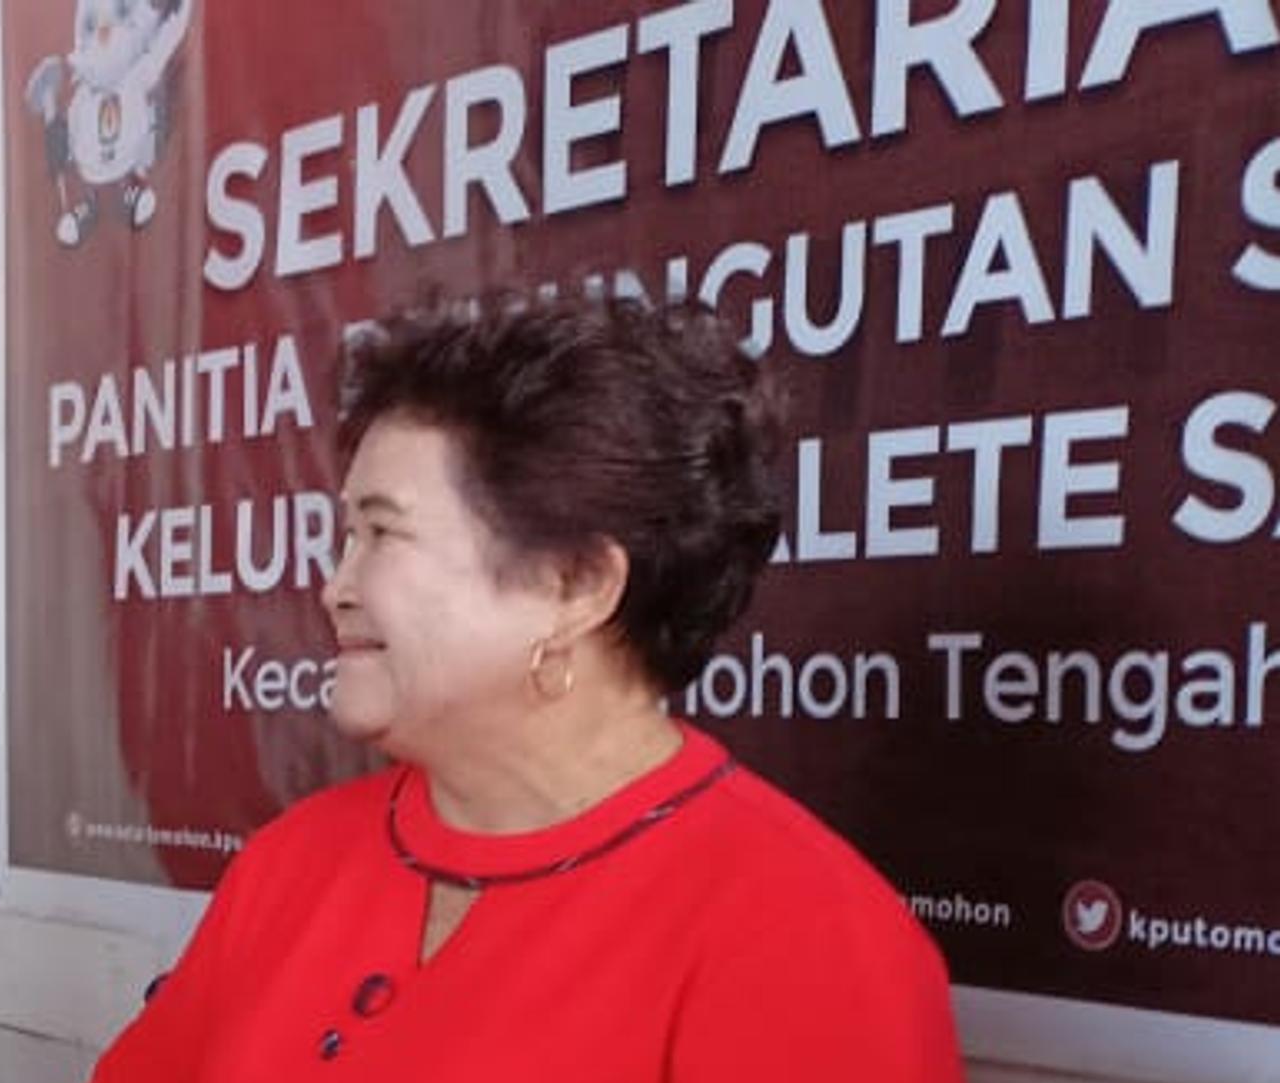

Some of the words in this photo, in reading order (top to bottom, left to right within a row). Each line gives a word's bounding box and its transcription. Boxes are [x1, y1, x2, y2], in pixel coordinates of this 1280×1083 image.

[48, 335, 314, 467] PANITIA
[113, 490, 354, 600] KELUR
[768, 405, 1130, 564] LETE
[1172, 390, 1280, 543] S
[658, 631, 900, 719] ohon
[901, 892, 1010, 927] mohon
